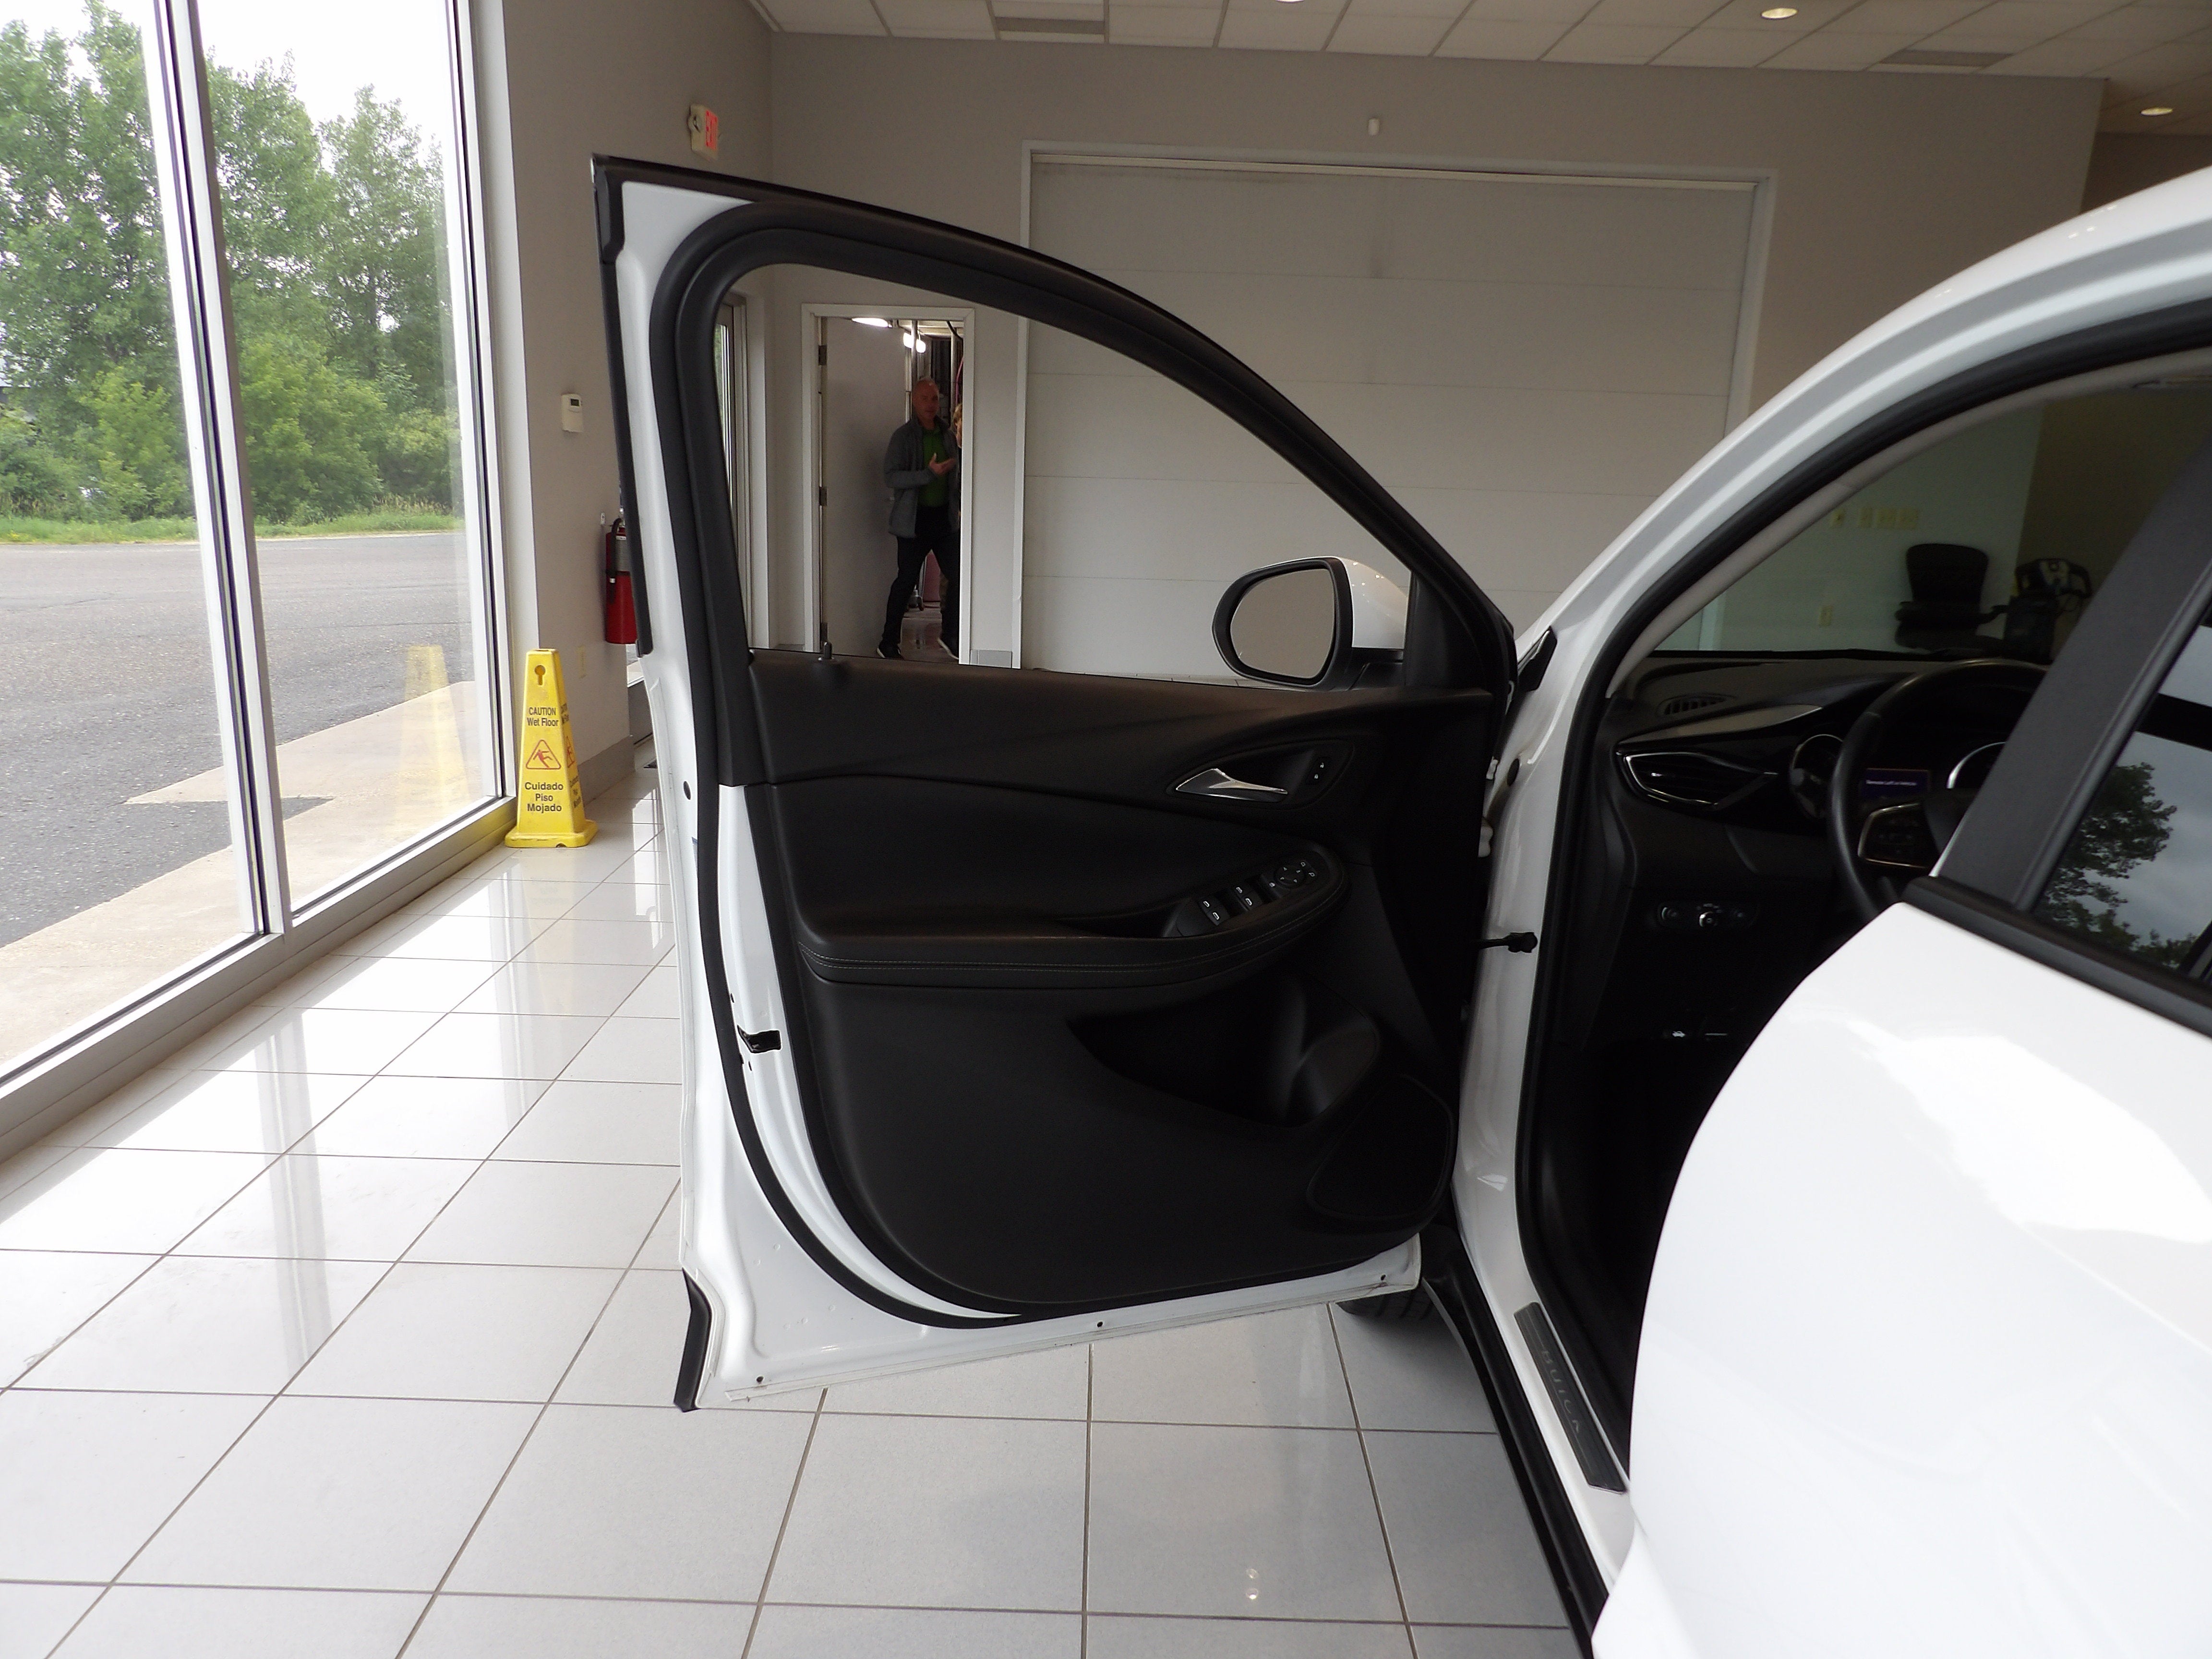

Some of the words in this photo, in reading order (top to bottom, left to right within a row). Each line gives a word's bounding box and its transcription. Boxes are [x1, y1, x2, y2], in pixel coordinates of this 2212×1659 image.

[529, 707, 556, 716] CAUTION
[527, 718, 540, 726] Wet
[541, 718, 559, 727] Floor
[525, 782, 564, 791] Cuidado
[535, 793, 553, 802] Piso
[527, 804, 562, 814] Mojado
